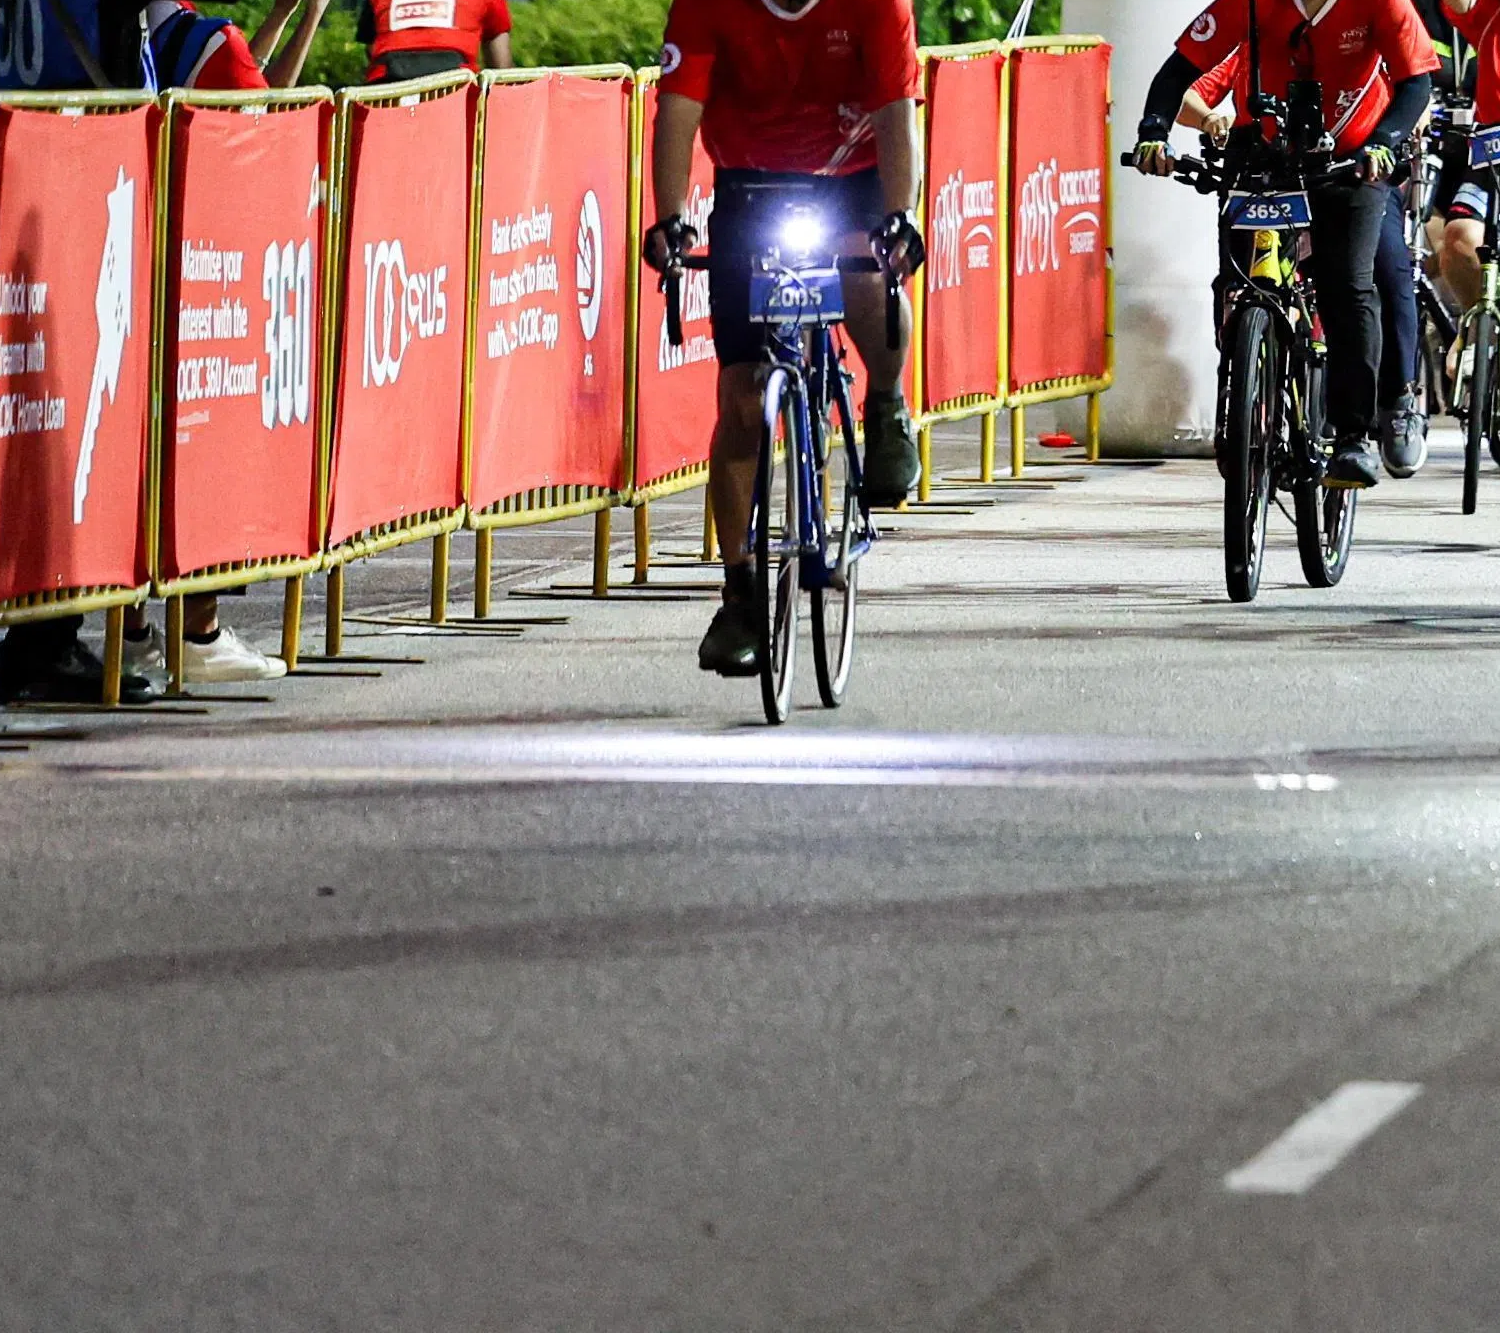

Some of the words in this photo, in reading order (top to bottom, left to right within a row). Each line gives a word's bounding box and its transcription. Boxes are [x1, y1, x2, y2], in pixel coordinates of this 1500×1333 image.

[1245, 202, 1293, 220] 3692
[181, 238, 222, 282] Maximise
[222, 250, 244, 292] your
[178, 297, 212, 343] interest
[213, 297, 232, 340] with
[233, 297, 248, 339] the
[261, 236, 312, 431] 360
[176, 357, 204, 404] OCBC
[205, 355, 222, 399] 360
[222, 356, 258, 397] Account
[44, 390, 66, 431] Loan
